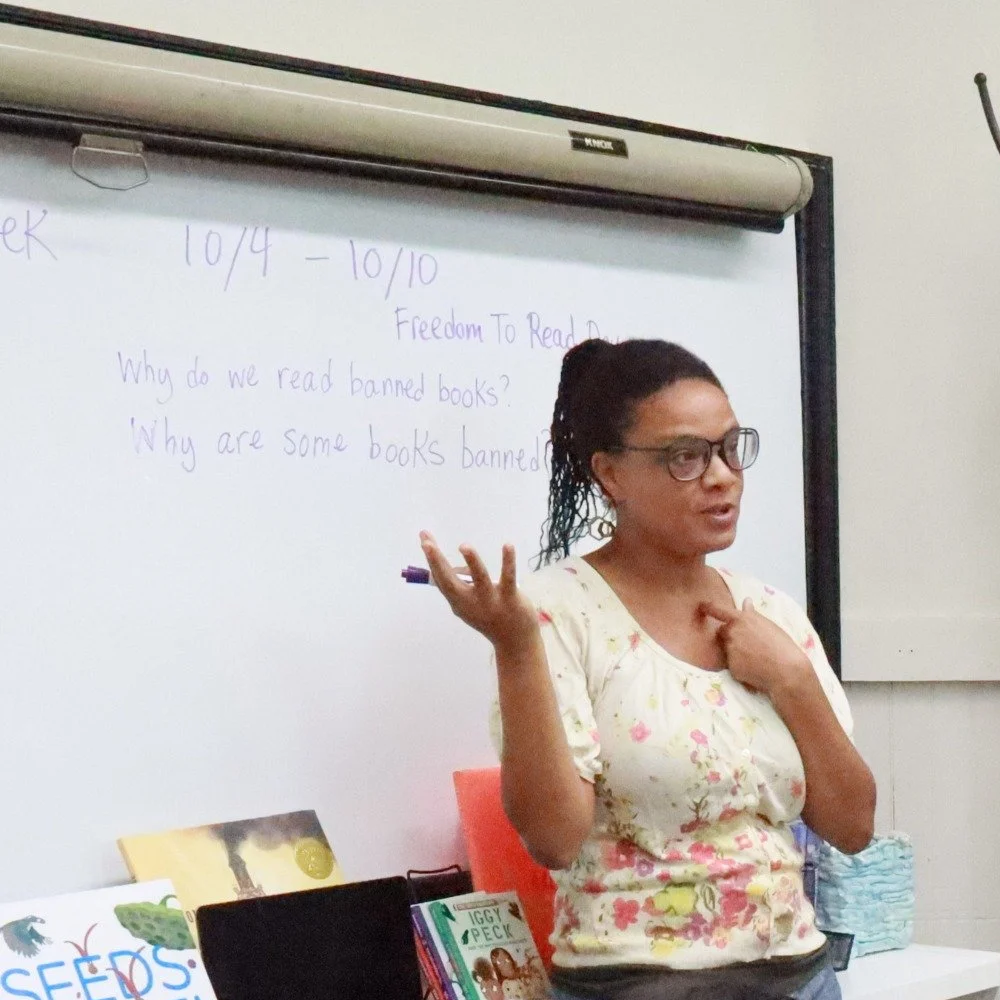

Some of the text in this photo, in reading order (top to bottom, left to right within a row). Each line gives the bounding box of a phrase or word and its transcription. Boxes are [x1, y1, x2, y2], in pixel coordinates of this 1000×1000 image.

[186, 224, 273, 292] 10/4
[348, 239, 439, 300] 10/10
[394, 305, 484, 344] Freedom
[490, 313, 517, 344] To
[526, 311, 576, 350] Read
[117, 348, 511, 408] Why do we read banned books?
[130, 416, 196, 473] Why
[217, 429, 264, 454] are
[283, 427, 349, 458] some
[368, 423, 445, 469] books
[468, 907, 502, 925] IGGY
[471, 923, 513, 942] PECK
